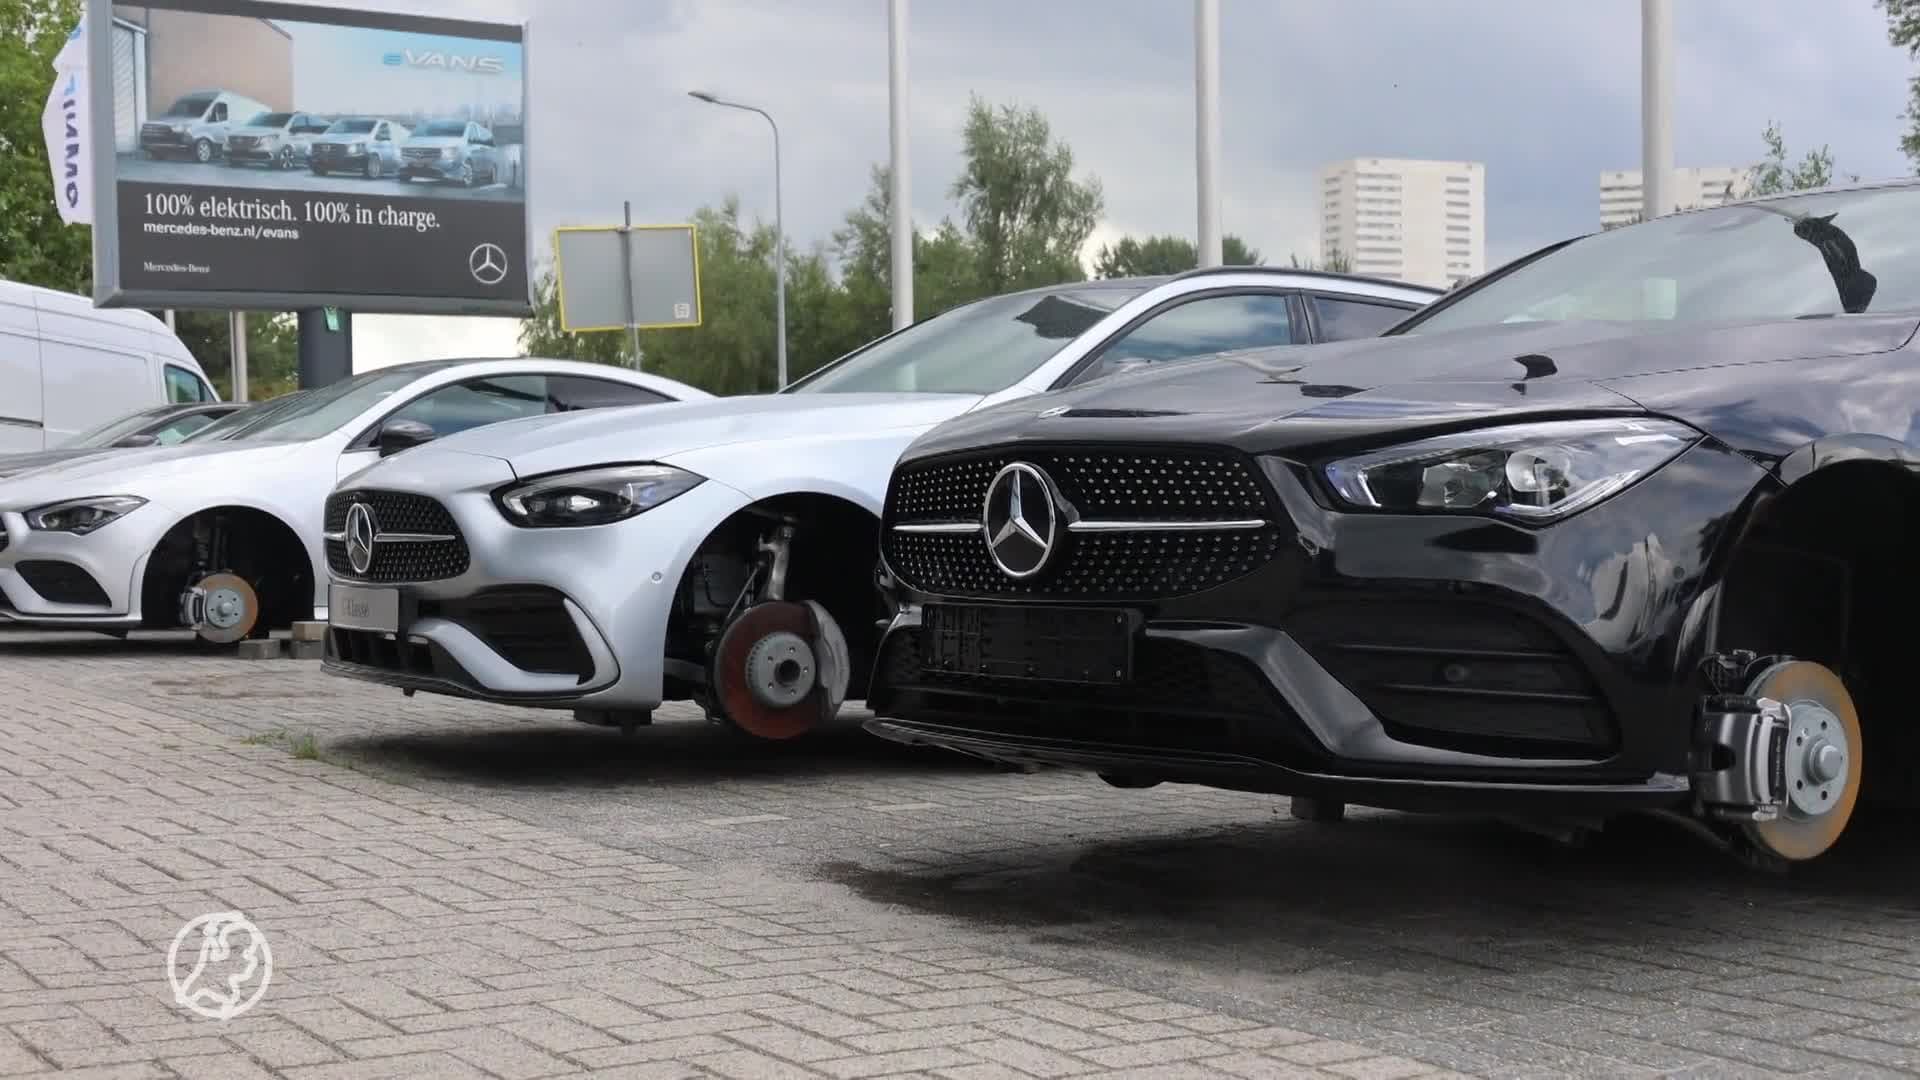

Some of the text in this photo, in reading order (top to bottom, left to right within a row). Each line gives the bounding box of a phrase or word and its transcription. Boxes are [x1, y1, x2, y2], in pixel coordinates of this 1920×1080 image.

[144, 193, 441, 233] 100% elektrisch. 100% in charge.
[143, 221, 300, 240] mercedes-benz.nl/evans
[143, 261, 210, 273] Mercedes-Benz
